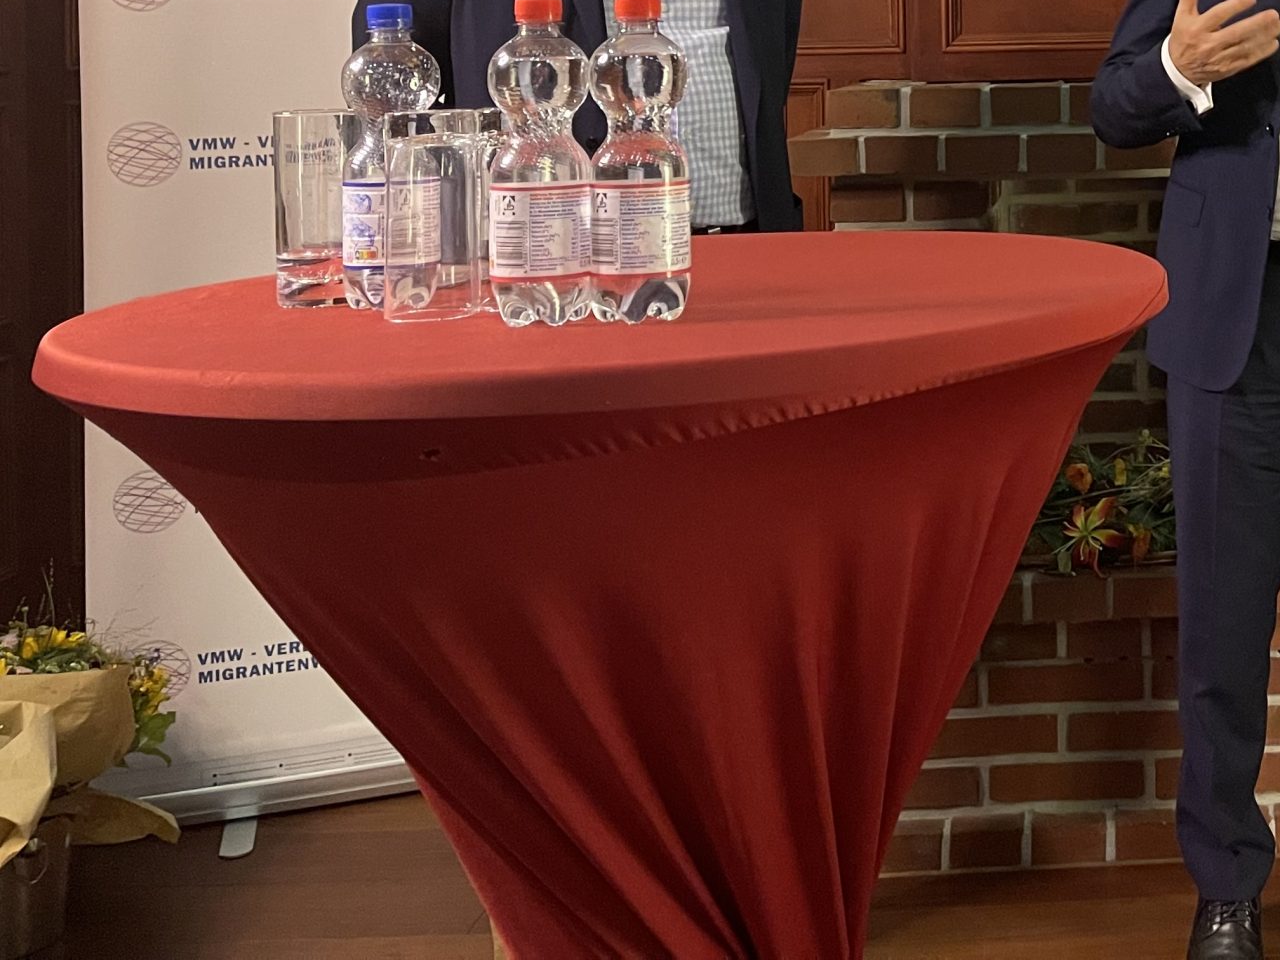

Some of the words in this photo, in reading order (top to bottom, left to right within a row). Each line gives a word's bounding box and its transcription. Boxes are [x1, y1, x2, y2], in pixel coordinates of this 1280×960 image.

[188, 137, 236, 151] VMW
[189, 154, 274, 169] MIGRANT
[197, 648, 243, 665] VMW
[264, 641, 305, 657] VER
